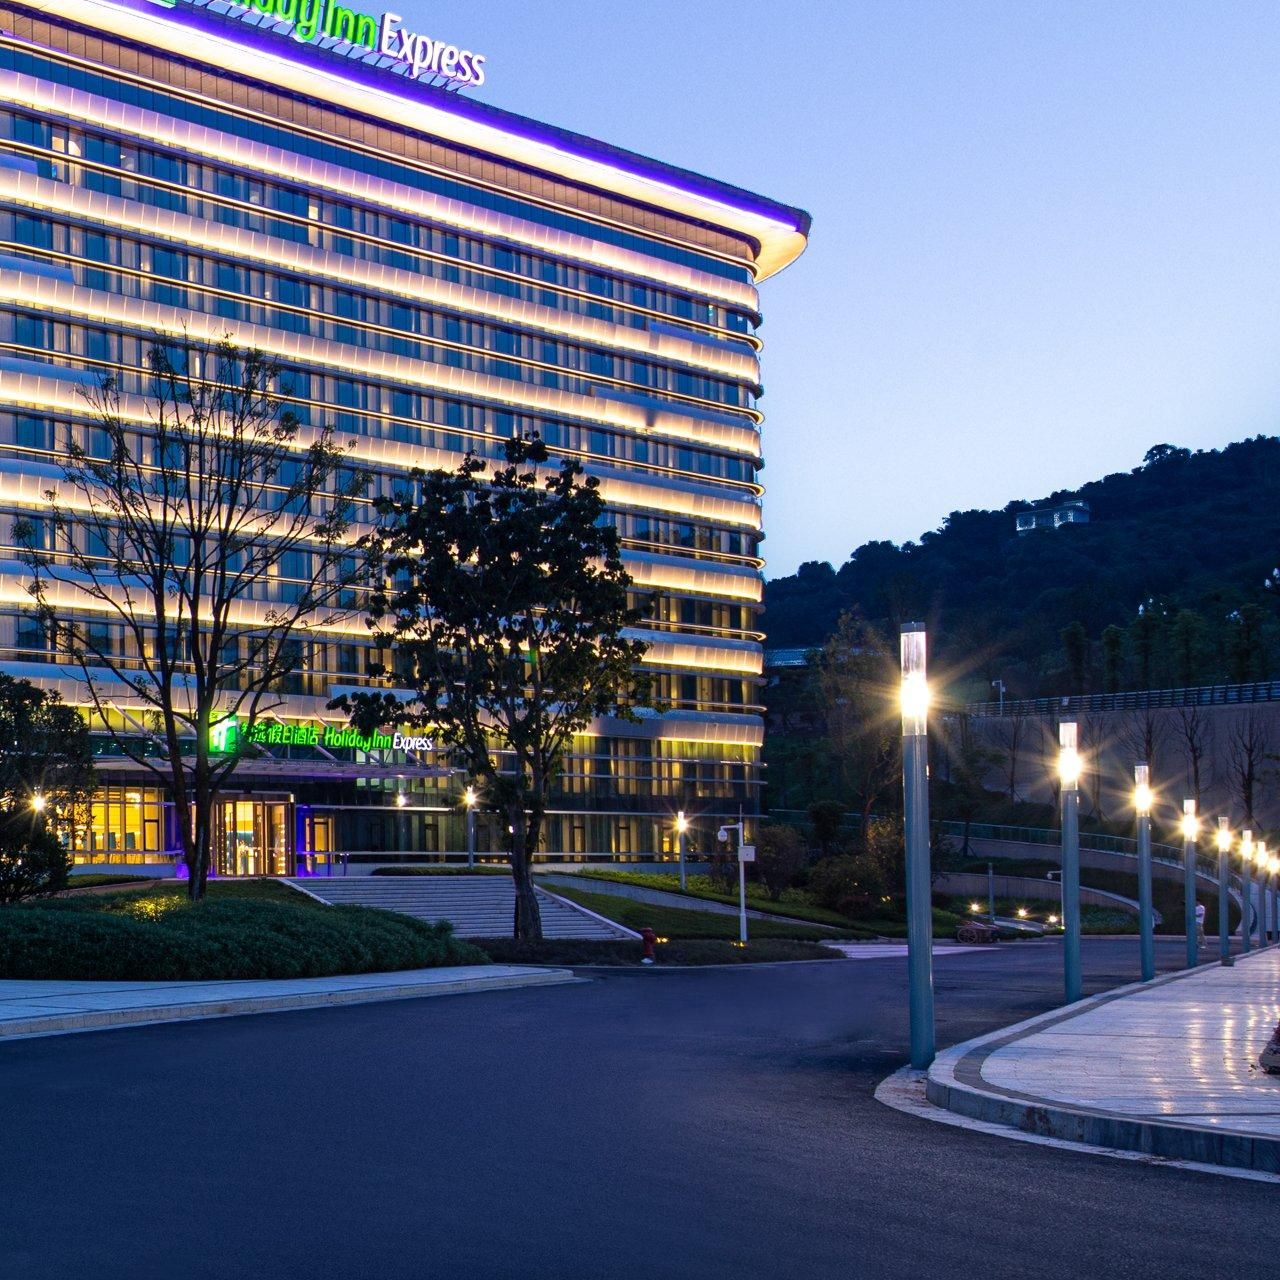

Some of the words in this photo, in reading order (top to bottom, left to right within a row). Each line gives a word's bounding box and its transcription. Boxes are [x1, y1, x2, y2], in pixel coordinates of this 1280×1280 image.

[380, 11, 487, 87] Express
[323, 725, 372, 753] Holiday
[372, 727, 392, 749] Inn
[392, 731, 433, 754] Express
